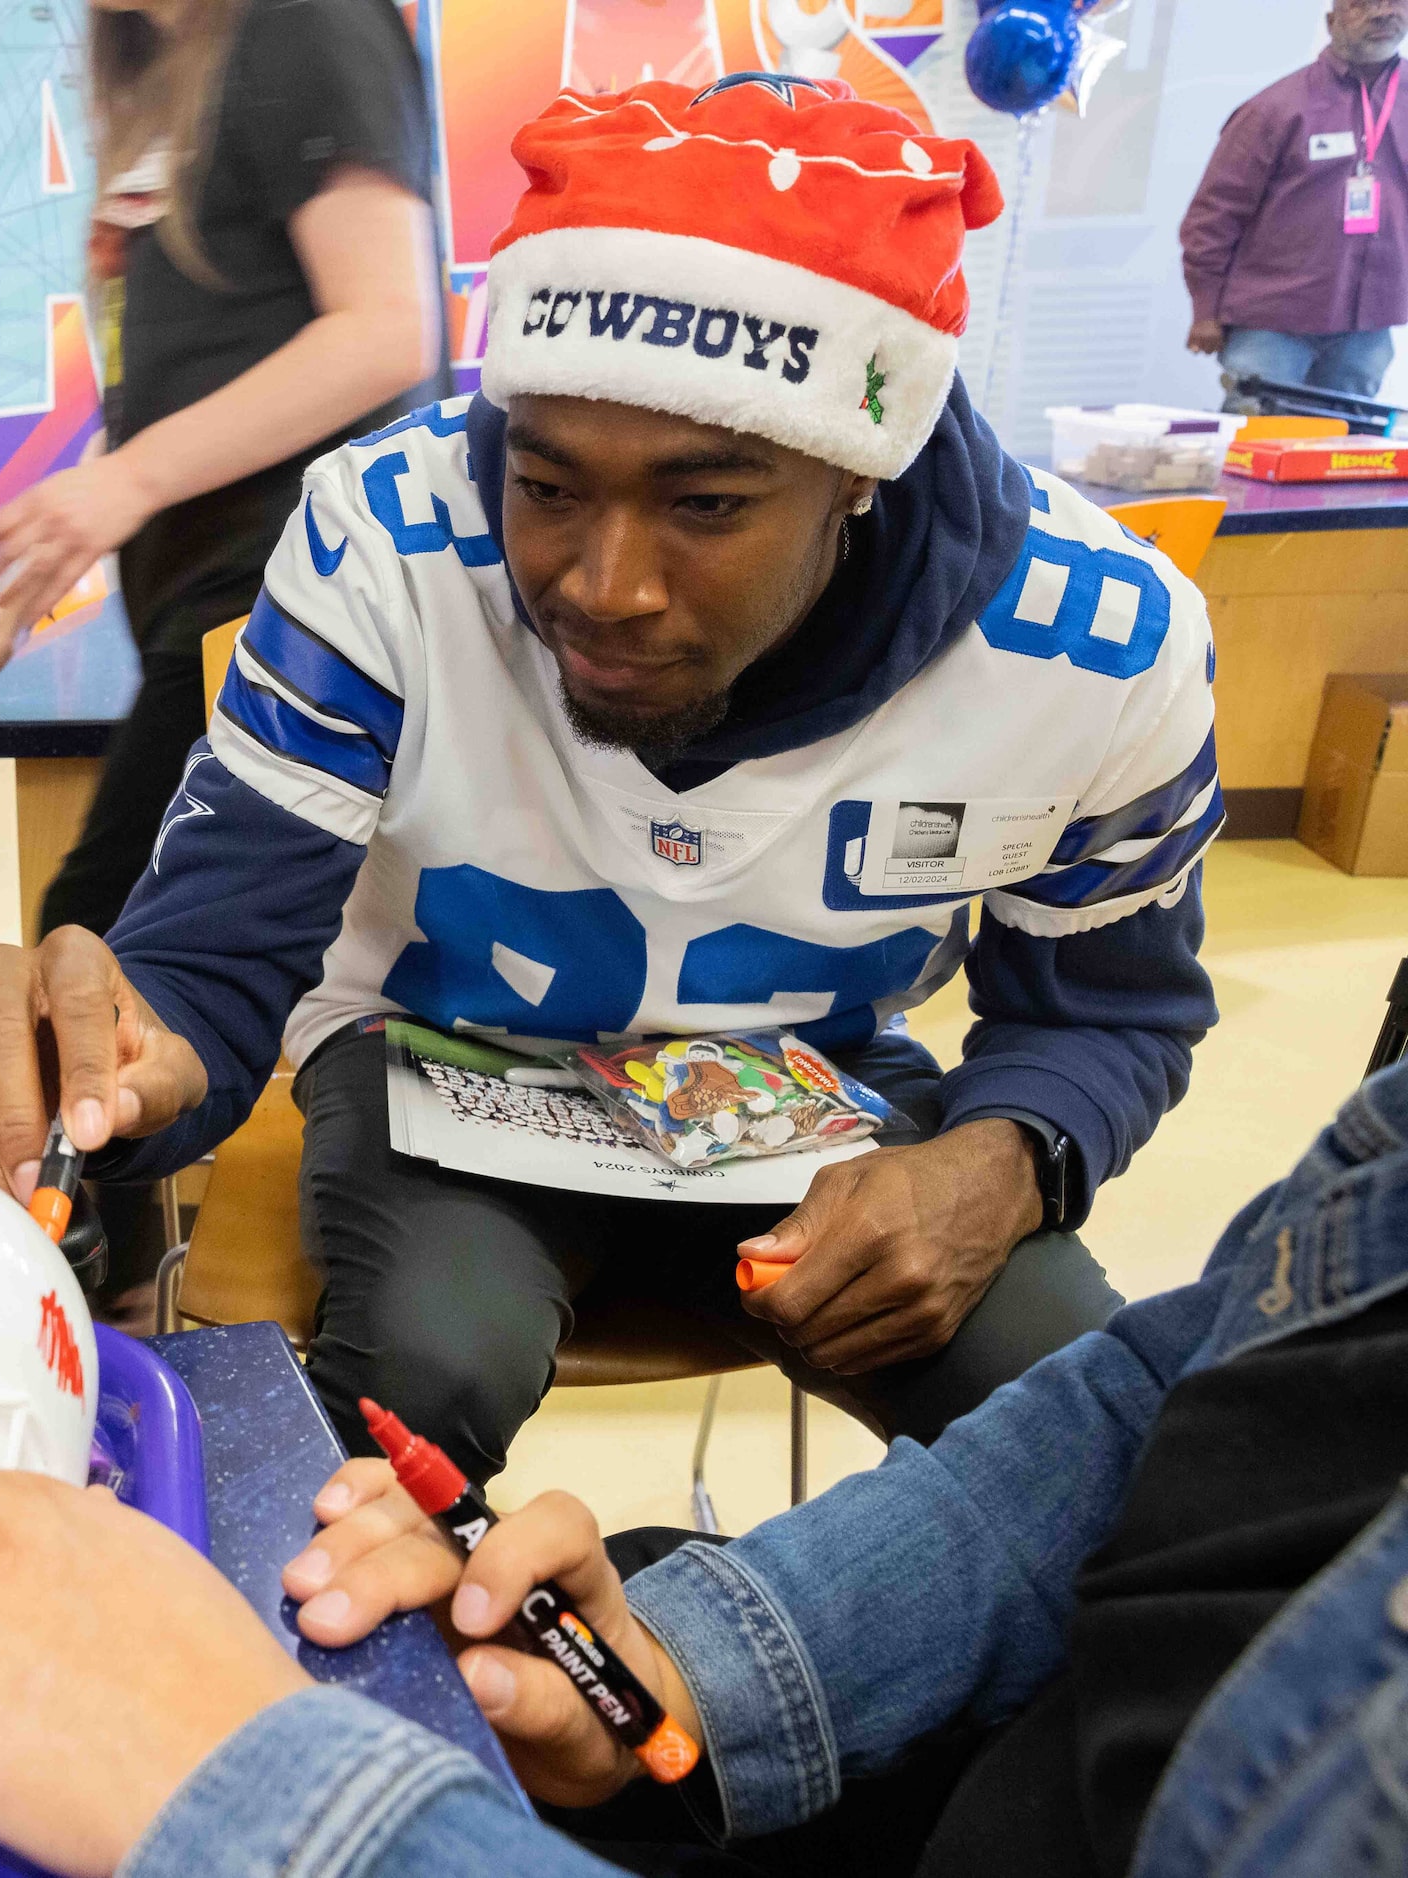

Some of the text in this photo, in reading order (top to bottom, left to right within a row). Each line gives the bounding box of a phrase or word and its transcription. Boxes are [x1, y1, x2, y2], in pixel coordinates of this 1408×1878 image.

[522, 287, 819, 384] COWBOYS
[657, 838, 696, 862] NFL
[1001, 841, 1033, 851] SPECIAL
[1002, 851, 1028, 860] GUEST
[906, 860, 945, 868] VISITOR
[988, 864, 1031, 877] LOB LOBBY
[898, 875, 948, 884] 12/02/2024
[791, 1054, 835, 1090] AMAZING!
[593, 1160, 725, 1178] COWBOYS 2024
[540, 1627, 597, 1684] PAINT
[586, 1681, 632, 1726] PEN
